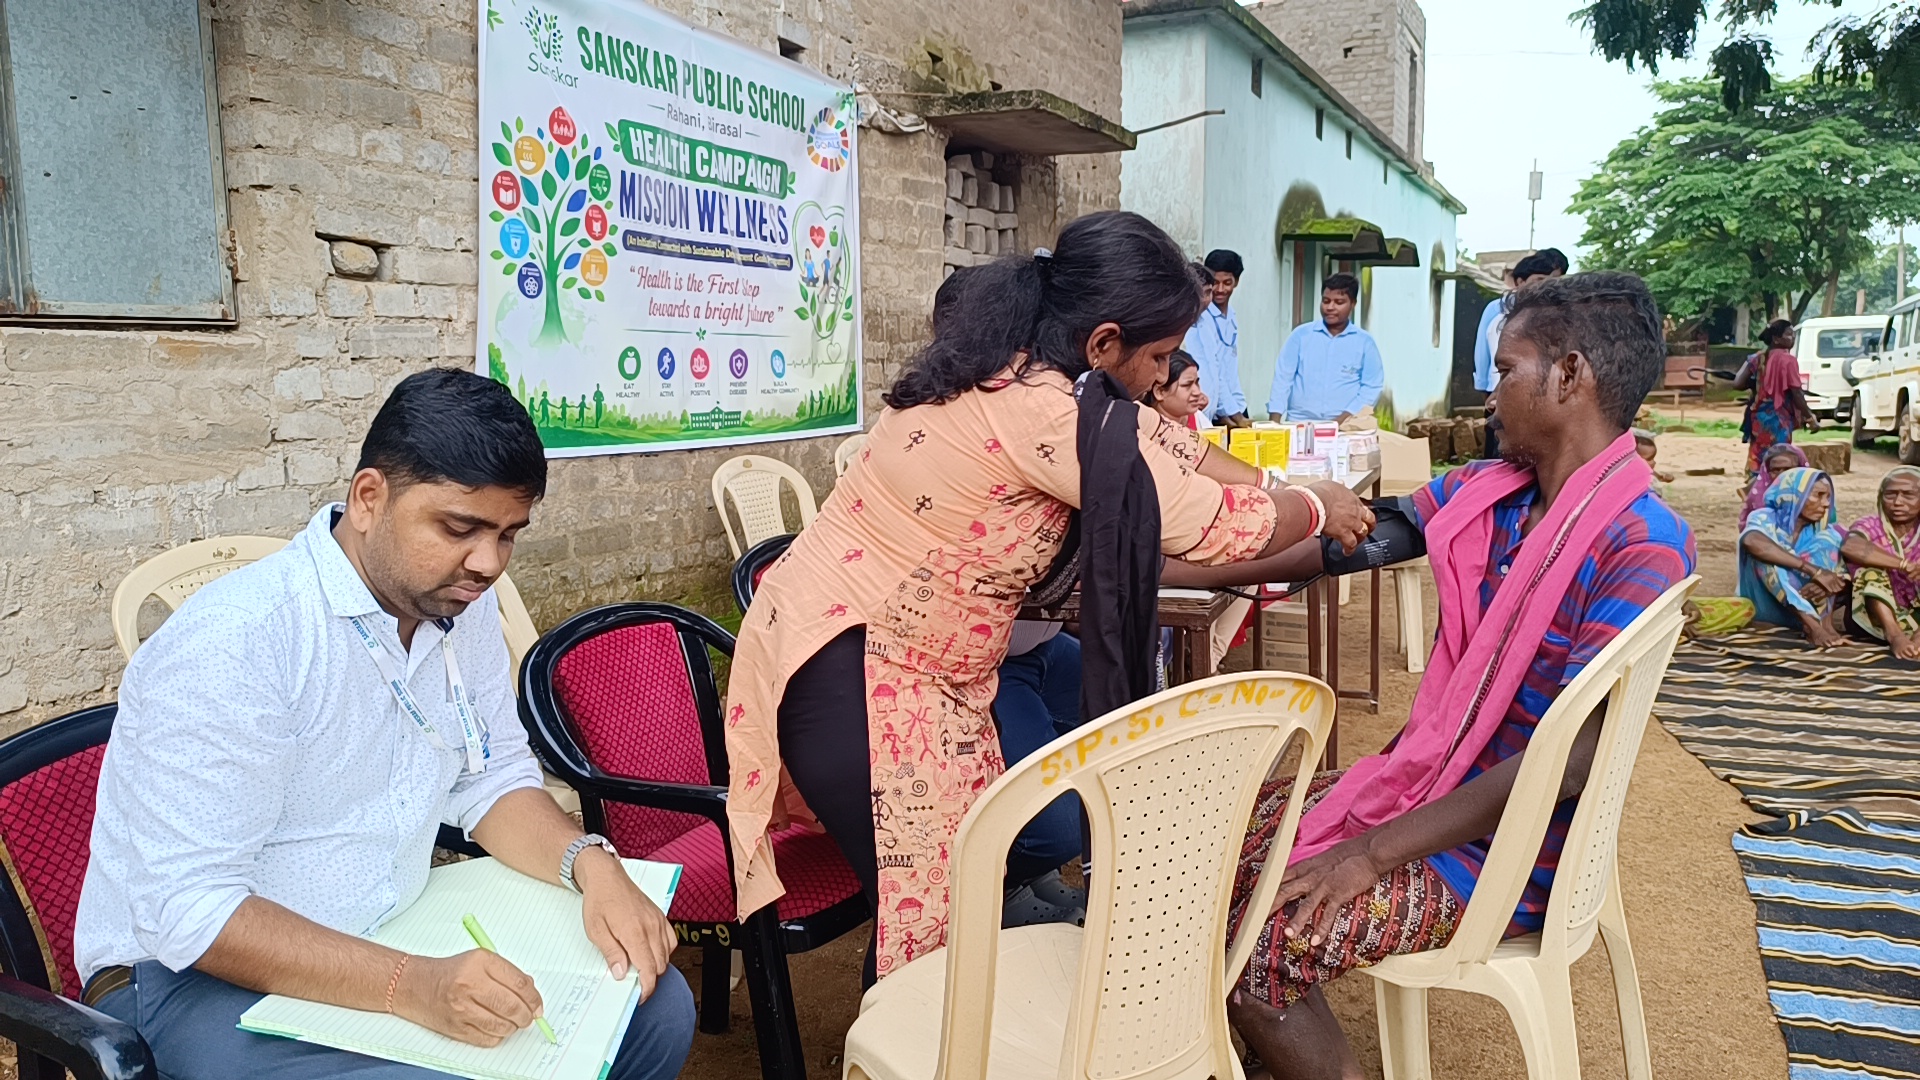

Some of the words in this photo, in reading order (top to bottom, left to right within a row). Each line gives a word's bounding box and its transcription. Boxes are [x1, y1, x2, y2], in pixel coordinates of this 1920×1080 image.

[576, 25, 679, 97] SANSKAR
[681, 59, 744, 115] PUBLIC
[747, 80, 807, 134] SCHOOL
[666, 103, 705, 131] Rahani,
[628, 126, 691, 175] HEALTH
[695, 145, 782, 195] CAMPAIGN
[619, 169, 690, 231] MISSION
[695, 188, 790, 245] WELLNESS
[674, 272, 683, 292] is
[686, 271, 705, 293] the
[707, 273, 740, 296] First
[648, 297, 691, 319] towards
[693, 305, 701, 319] a
[704, 301, 744, 327] bright
